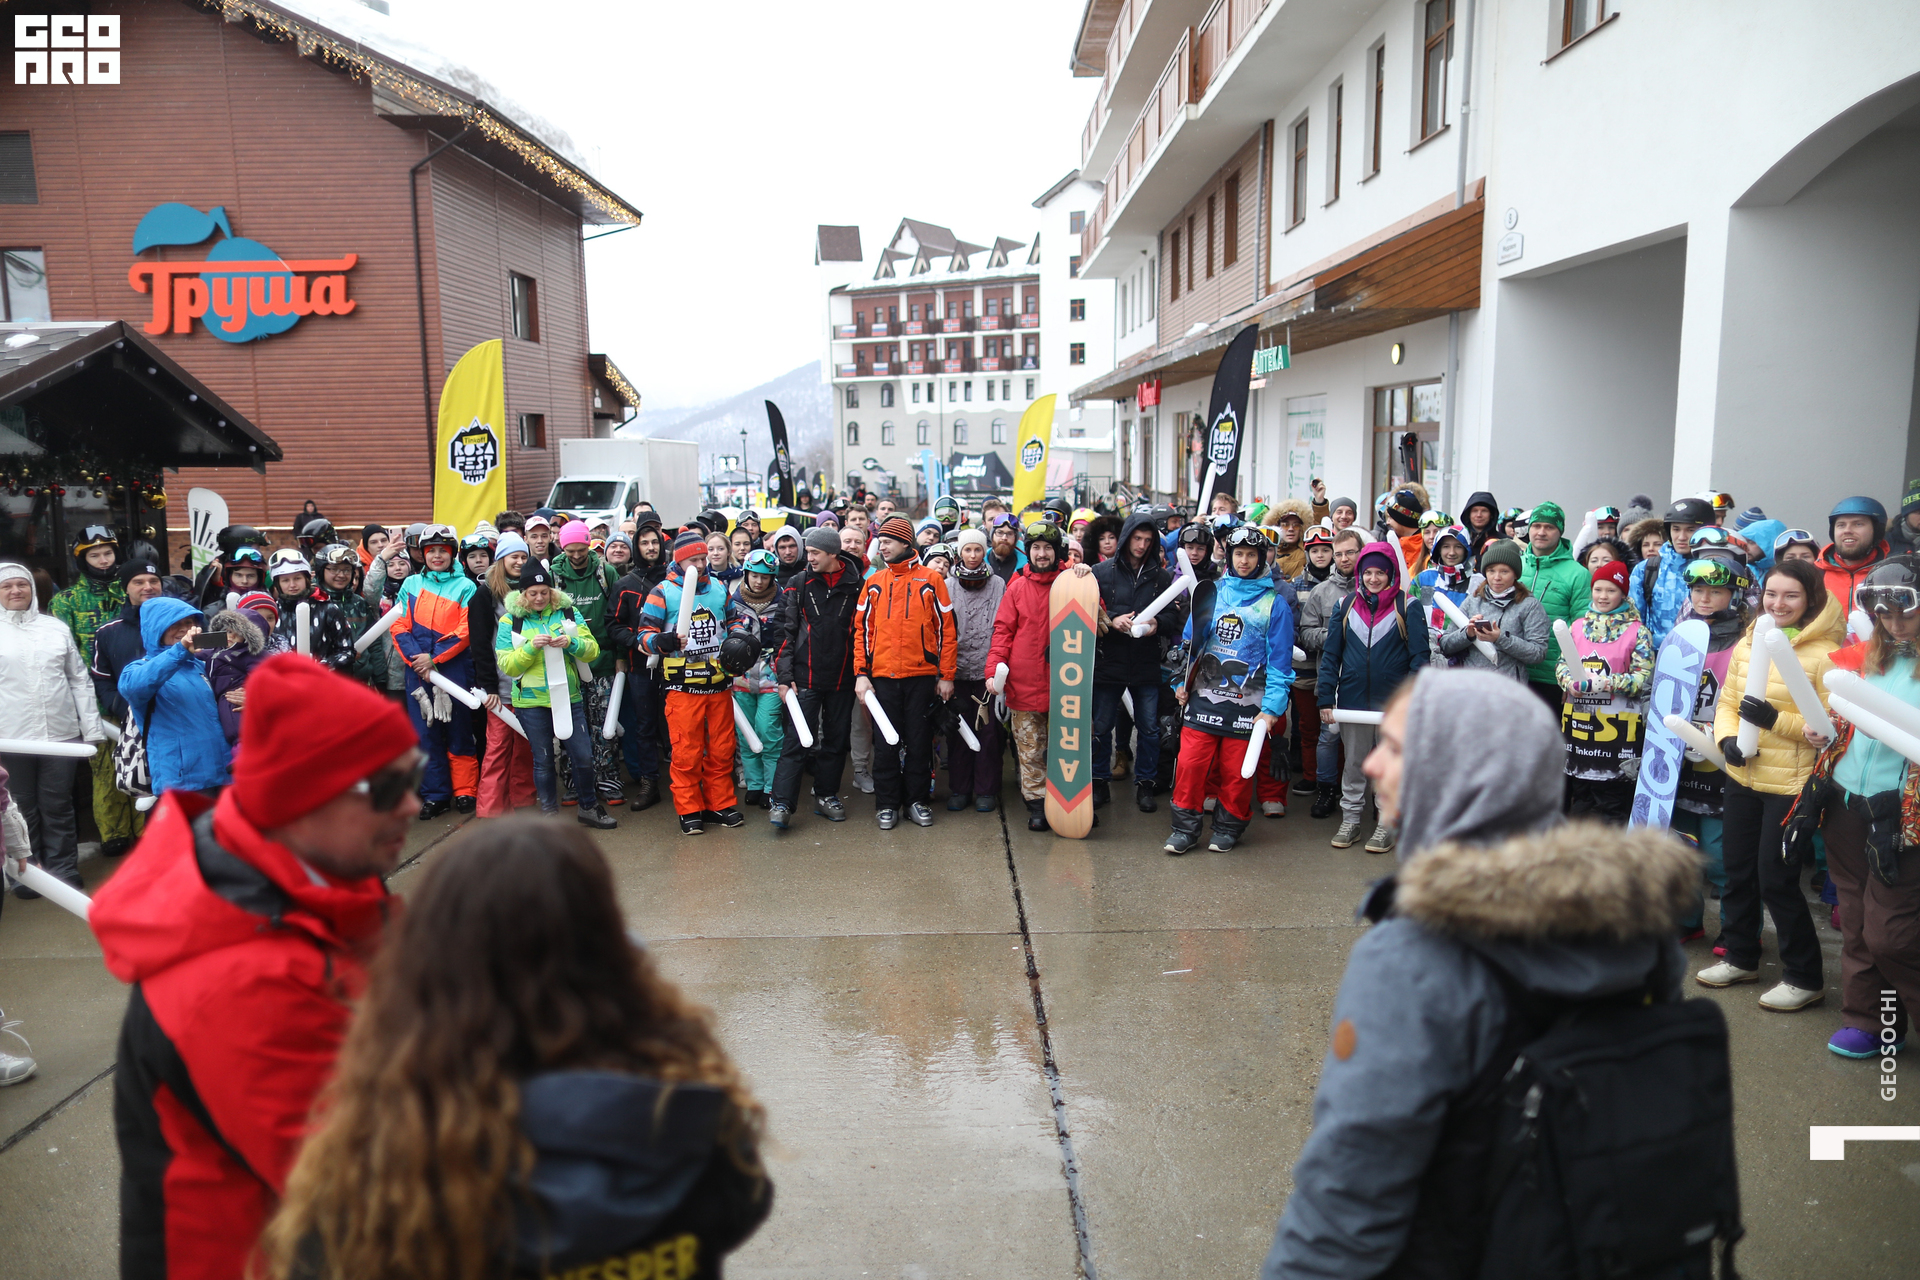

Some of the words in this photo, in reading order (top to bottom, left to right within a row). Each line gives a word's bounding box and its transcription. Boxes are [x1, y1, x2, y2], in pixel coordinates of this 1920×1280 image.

[128, 253, 358, 335] Груша
[1213, 428, 1235, 444] ROSA
[1301, 422, 1324, 439] АПТЕКА
[454, 441, 495, 456] ROSA
[1212, 444, 1233, 460] FEST
[455, 455, 493, 470] FEST
[689, 627, 714, 638] FEST
[1217, 620, 1241, 632] ROSA
[1217, 628, 1240, 640] FEST
[1196, 713, 1224, 726] TELE2
[1232, 721, 1253, 729] GORILL
[1562, 702, 1641, 742] FEST
[1577, 723, 1594, 731] music
[1575, 746, 1612, 758] Tinkoff.ru
